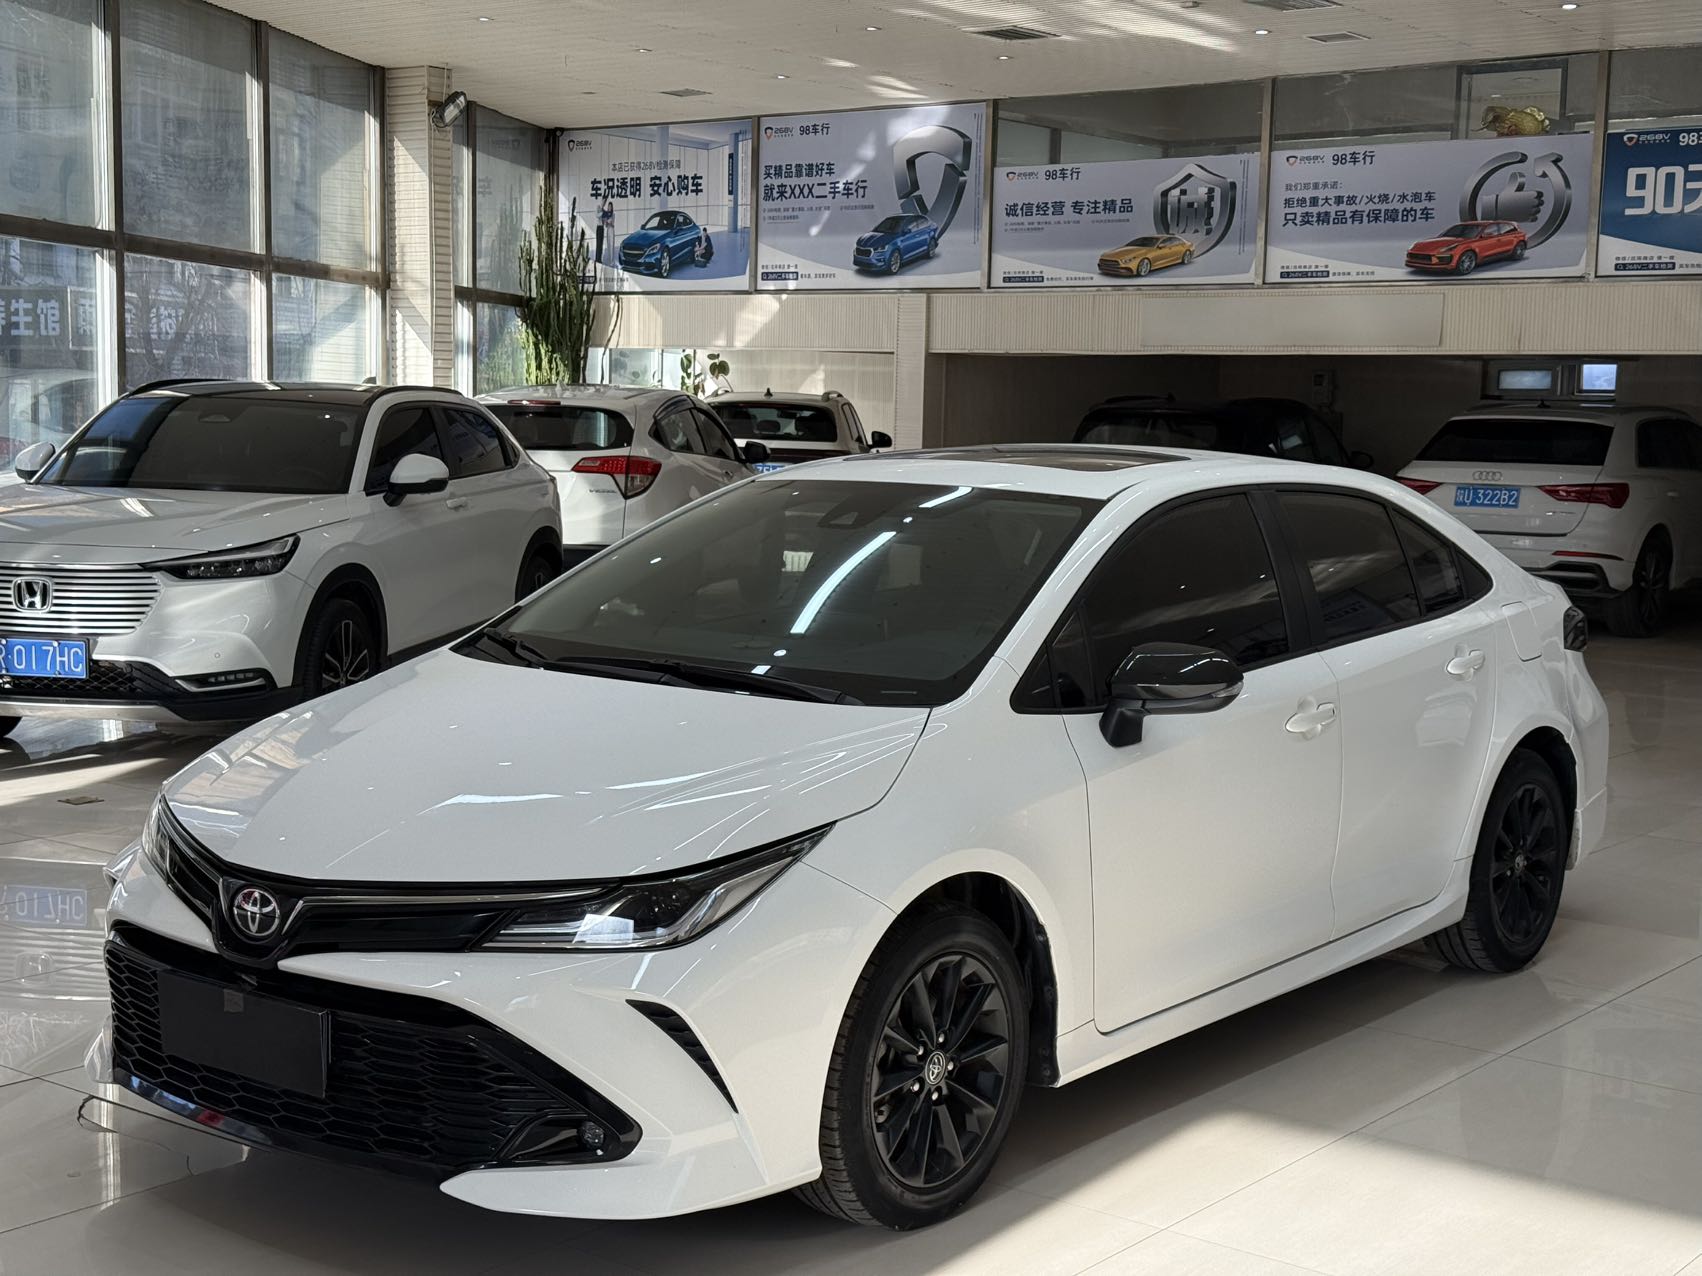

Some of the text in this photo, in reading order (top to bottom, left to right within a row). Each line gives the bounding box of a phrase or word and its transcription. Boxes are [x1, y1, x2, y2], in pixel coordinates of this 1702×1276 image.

[799, 123, 830, 136] 98车行
[1679, 132, 1702, 146] 98
[1332, 151, 1376, 166] 98车行
[763, 162, 835, 180] 买精品靠谱好车
[1044, 167, 1081, 181] 98车行
[590, 176, 642, 200] 车况透明
[649, 173, 704, 198] 安心购车
[763, 179, 868, 202] 就来XXX二手车行
[1004, 198, 1134, 217] 诚信经营 专注精品
[1283, 191, 1436, 209] 拒绝重大事故/火烧/水泡车
[1282, 206, 1435, 227] 只卖精品有保障的车
[0, 298, 60, 336] 生馆
